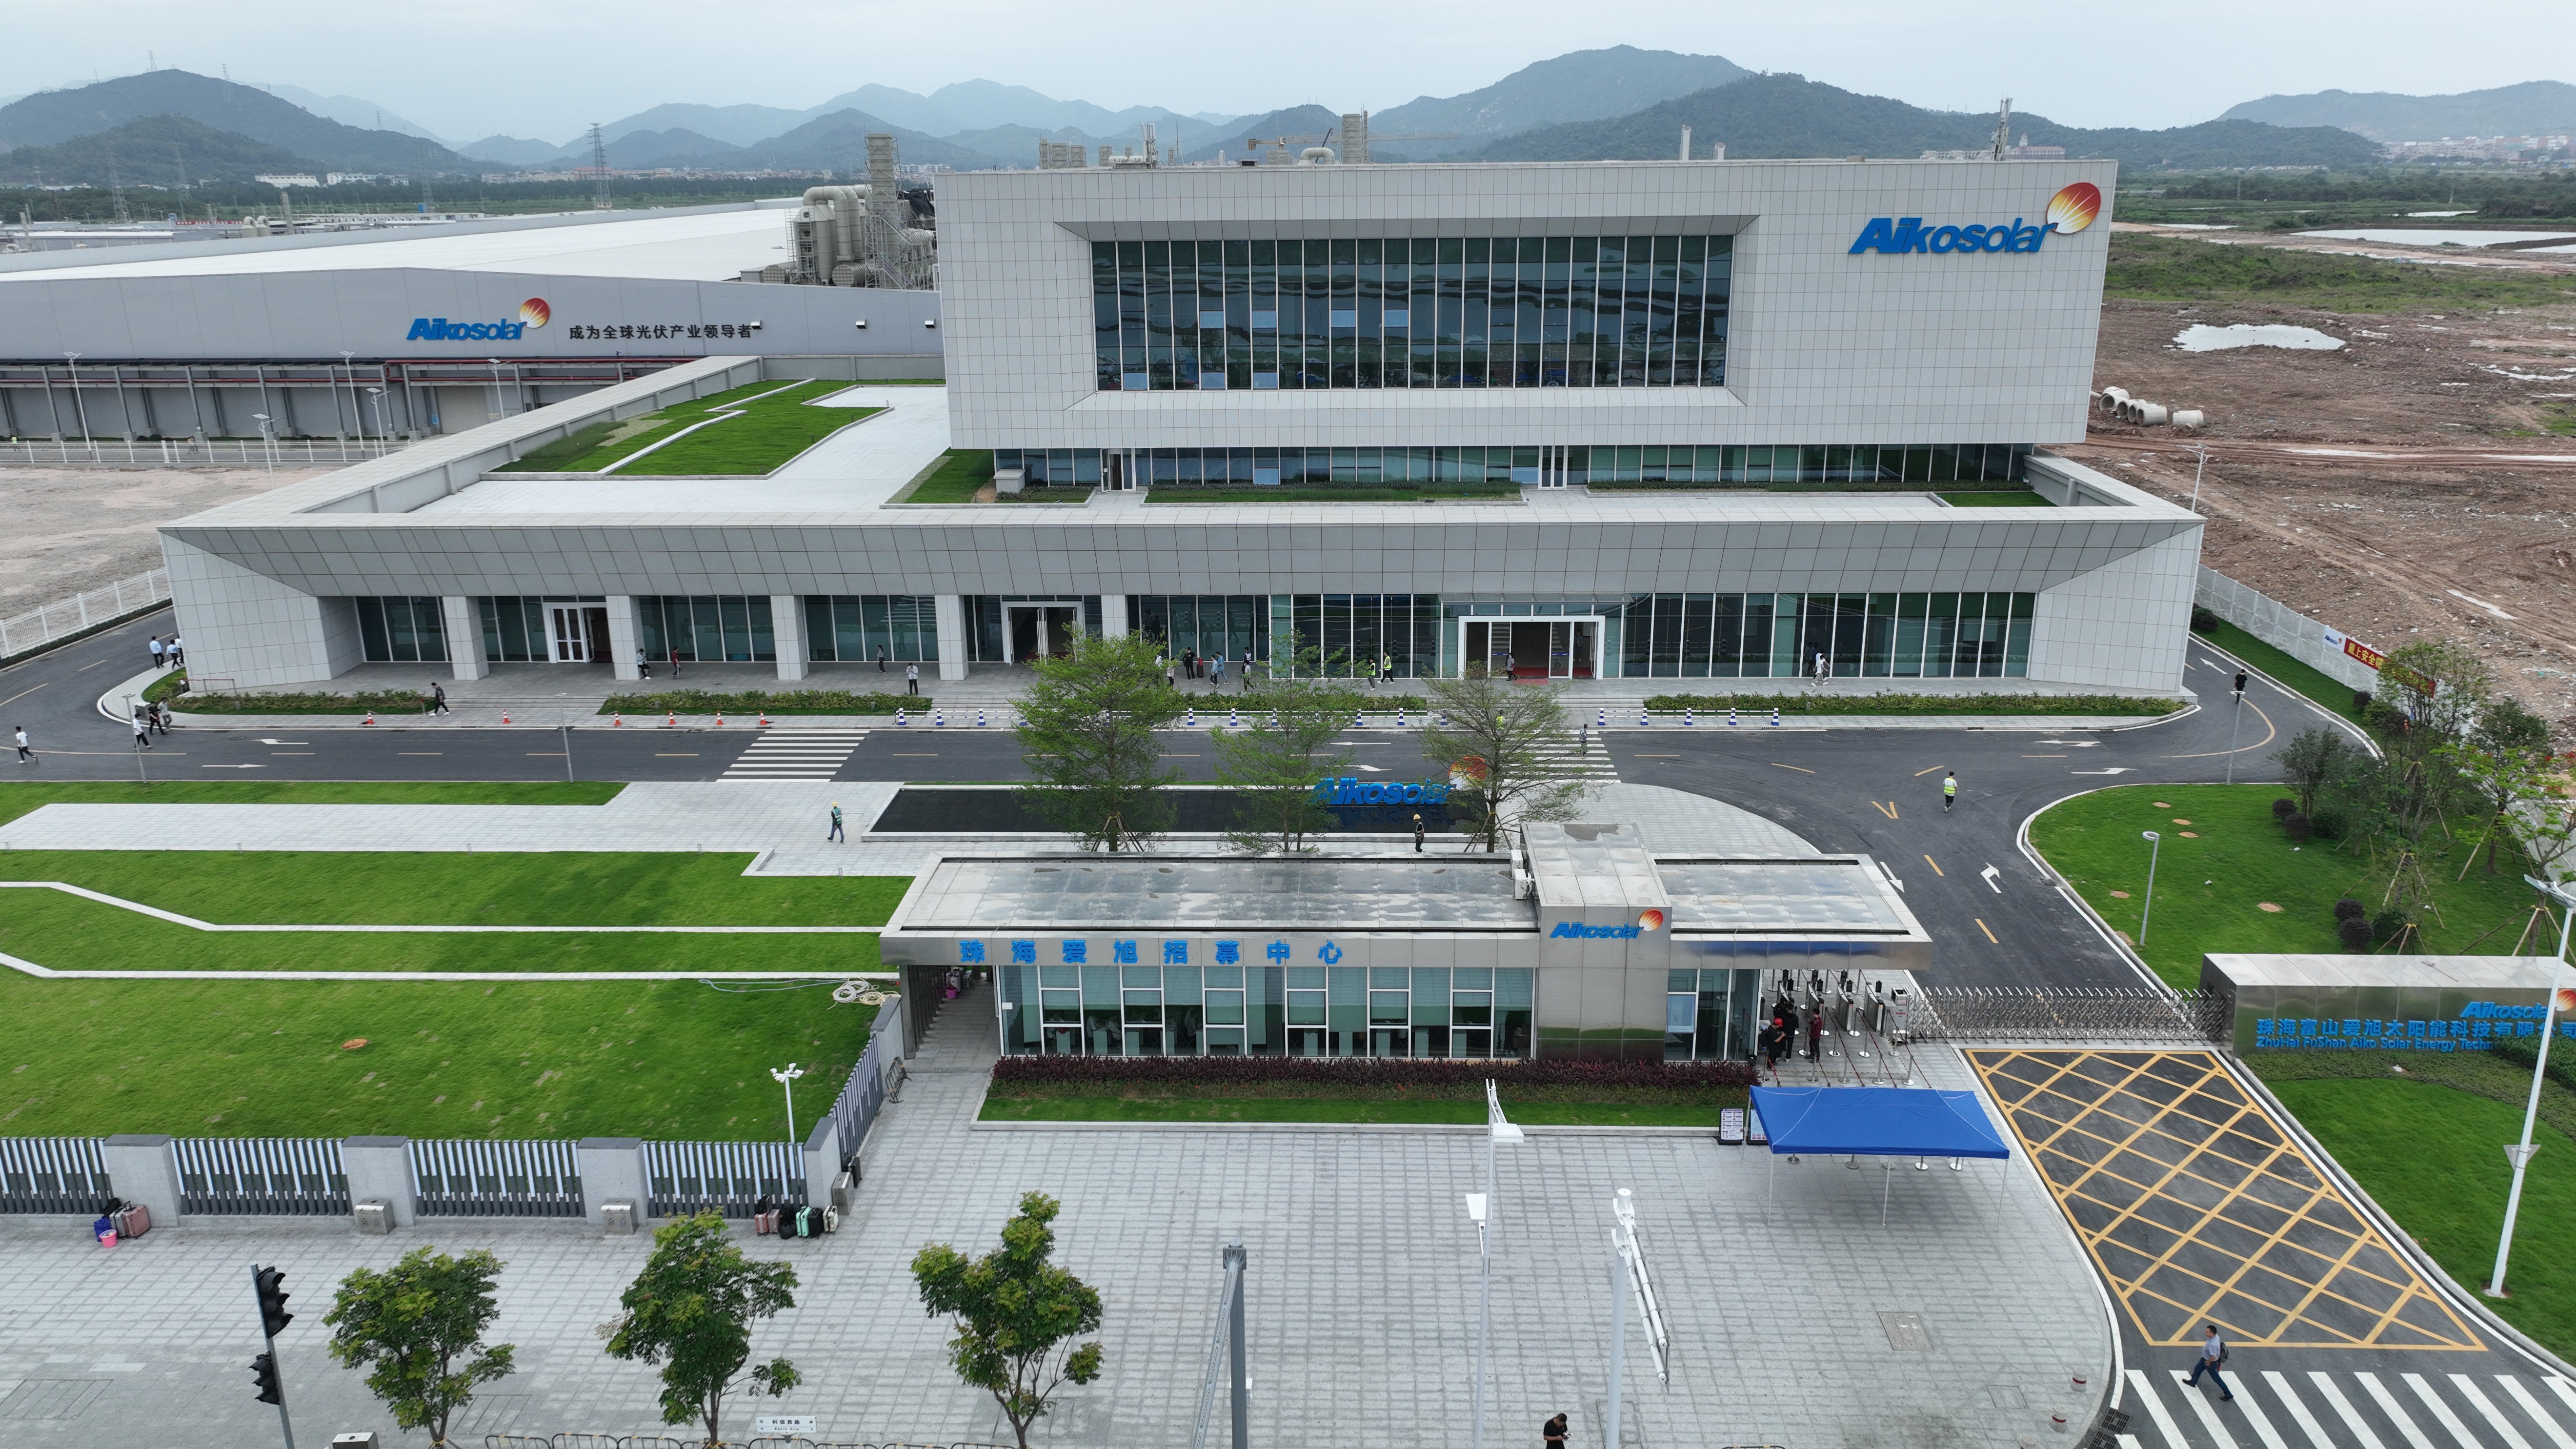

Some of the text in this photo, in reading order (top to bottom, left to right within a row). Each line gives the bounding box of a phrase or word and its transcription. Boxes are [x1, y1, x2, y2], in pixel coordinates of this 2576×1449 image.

[1849, 217, 2056, 254] Aikosolar
[406, 318, 526, 341] Aikosolar
[569, 324, 751, 340] 成为全球光伏产业领导者
[1550, 922, 1643, 939] Aikosolar
[959, 939, 1343, 965] 珠海爱旭招募中心
[2460, 1001, 2556, 1019] Aikosola
[2255, 1036, 2300, 1048] ZhuHai
[2303, 1036, 2347, 1048] FuShan
[2349, 1037, 2377, 1048] Aiko
[2380, 1037, 2412, 1049] Solar
[2414, 1037, 2456, 1052] Energy
